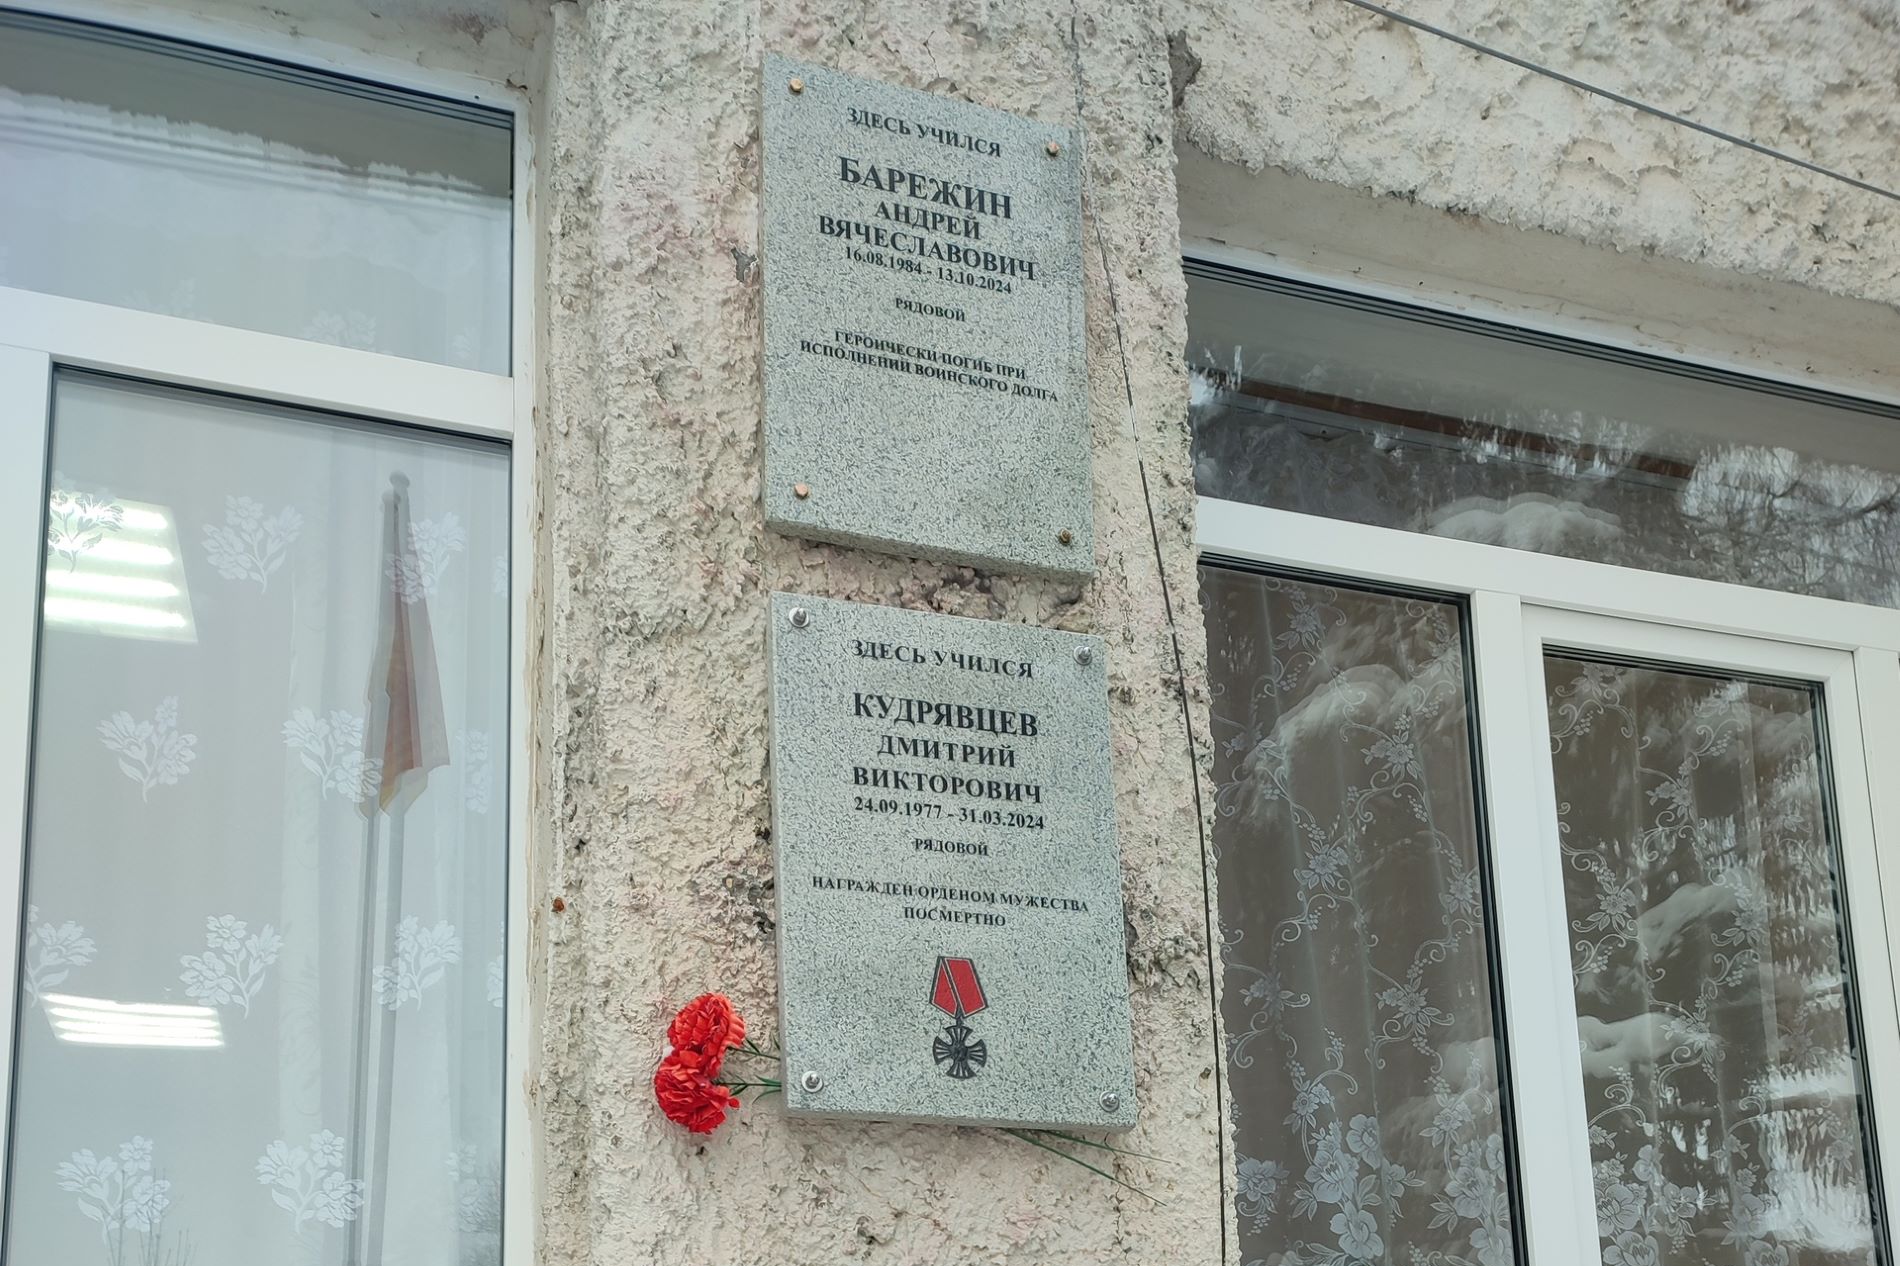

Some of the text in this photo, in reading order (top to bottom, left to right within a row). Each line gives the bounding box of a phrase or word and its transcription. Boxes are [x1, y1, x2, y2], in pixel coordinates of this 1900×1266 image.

[847, 107, 1001, 157] ЗДЕСЬ УЧИЛСЯ
[839, 155, 1012, 219] БАРЕЖИН
[874, 200, 981, 241] АНДРЕЙ
[818, 215, 1037, 281] ВЯЧЕСЛАВОВИЧ
[846, 246, 922, 275] 16.08.1984
[937, 266, 1012, 294] 13.10.2024
[895, 297, 966, 322] РЯДОВОЙ
[801, 340, 1058, 402] ИСПОЛНЕНИИ ВОИНСКОГО ДОЛГА
[835, 330, 1026, 380] ГЕРОИЧЕСКИ ПОГИБ ПРИ
[851, 639, 1033, 679] ЗДЕСЬ УЧИЛСЯ
[853, 692, 1038, 737] КУДРЯВЦЕВ
[877, 734, 1016, 768] ДМИТРИЙ
[853, 766, 1042, 804] ВИКТОРОВИЧ
[854, 796, 942, 819] 24.09.1977
[958, 808, 1044, 829] 31.03.2024
[914, 838, 988, 856] РЯДОВОЙ
[812, 875, 1089, 912] НАГРАЖДЕН ОРДЕНОМ МУЖЕСТВА
[904, 906, 1006, 927] ПОСМЕРТНО
